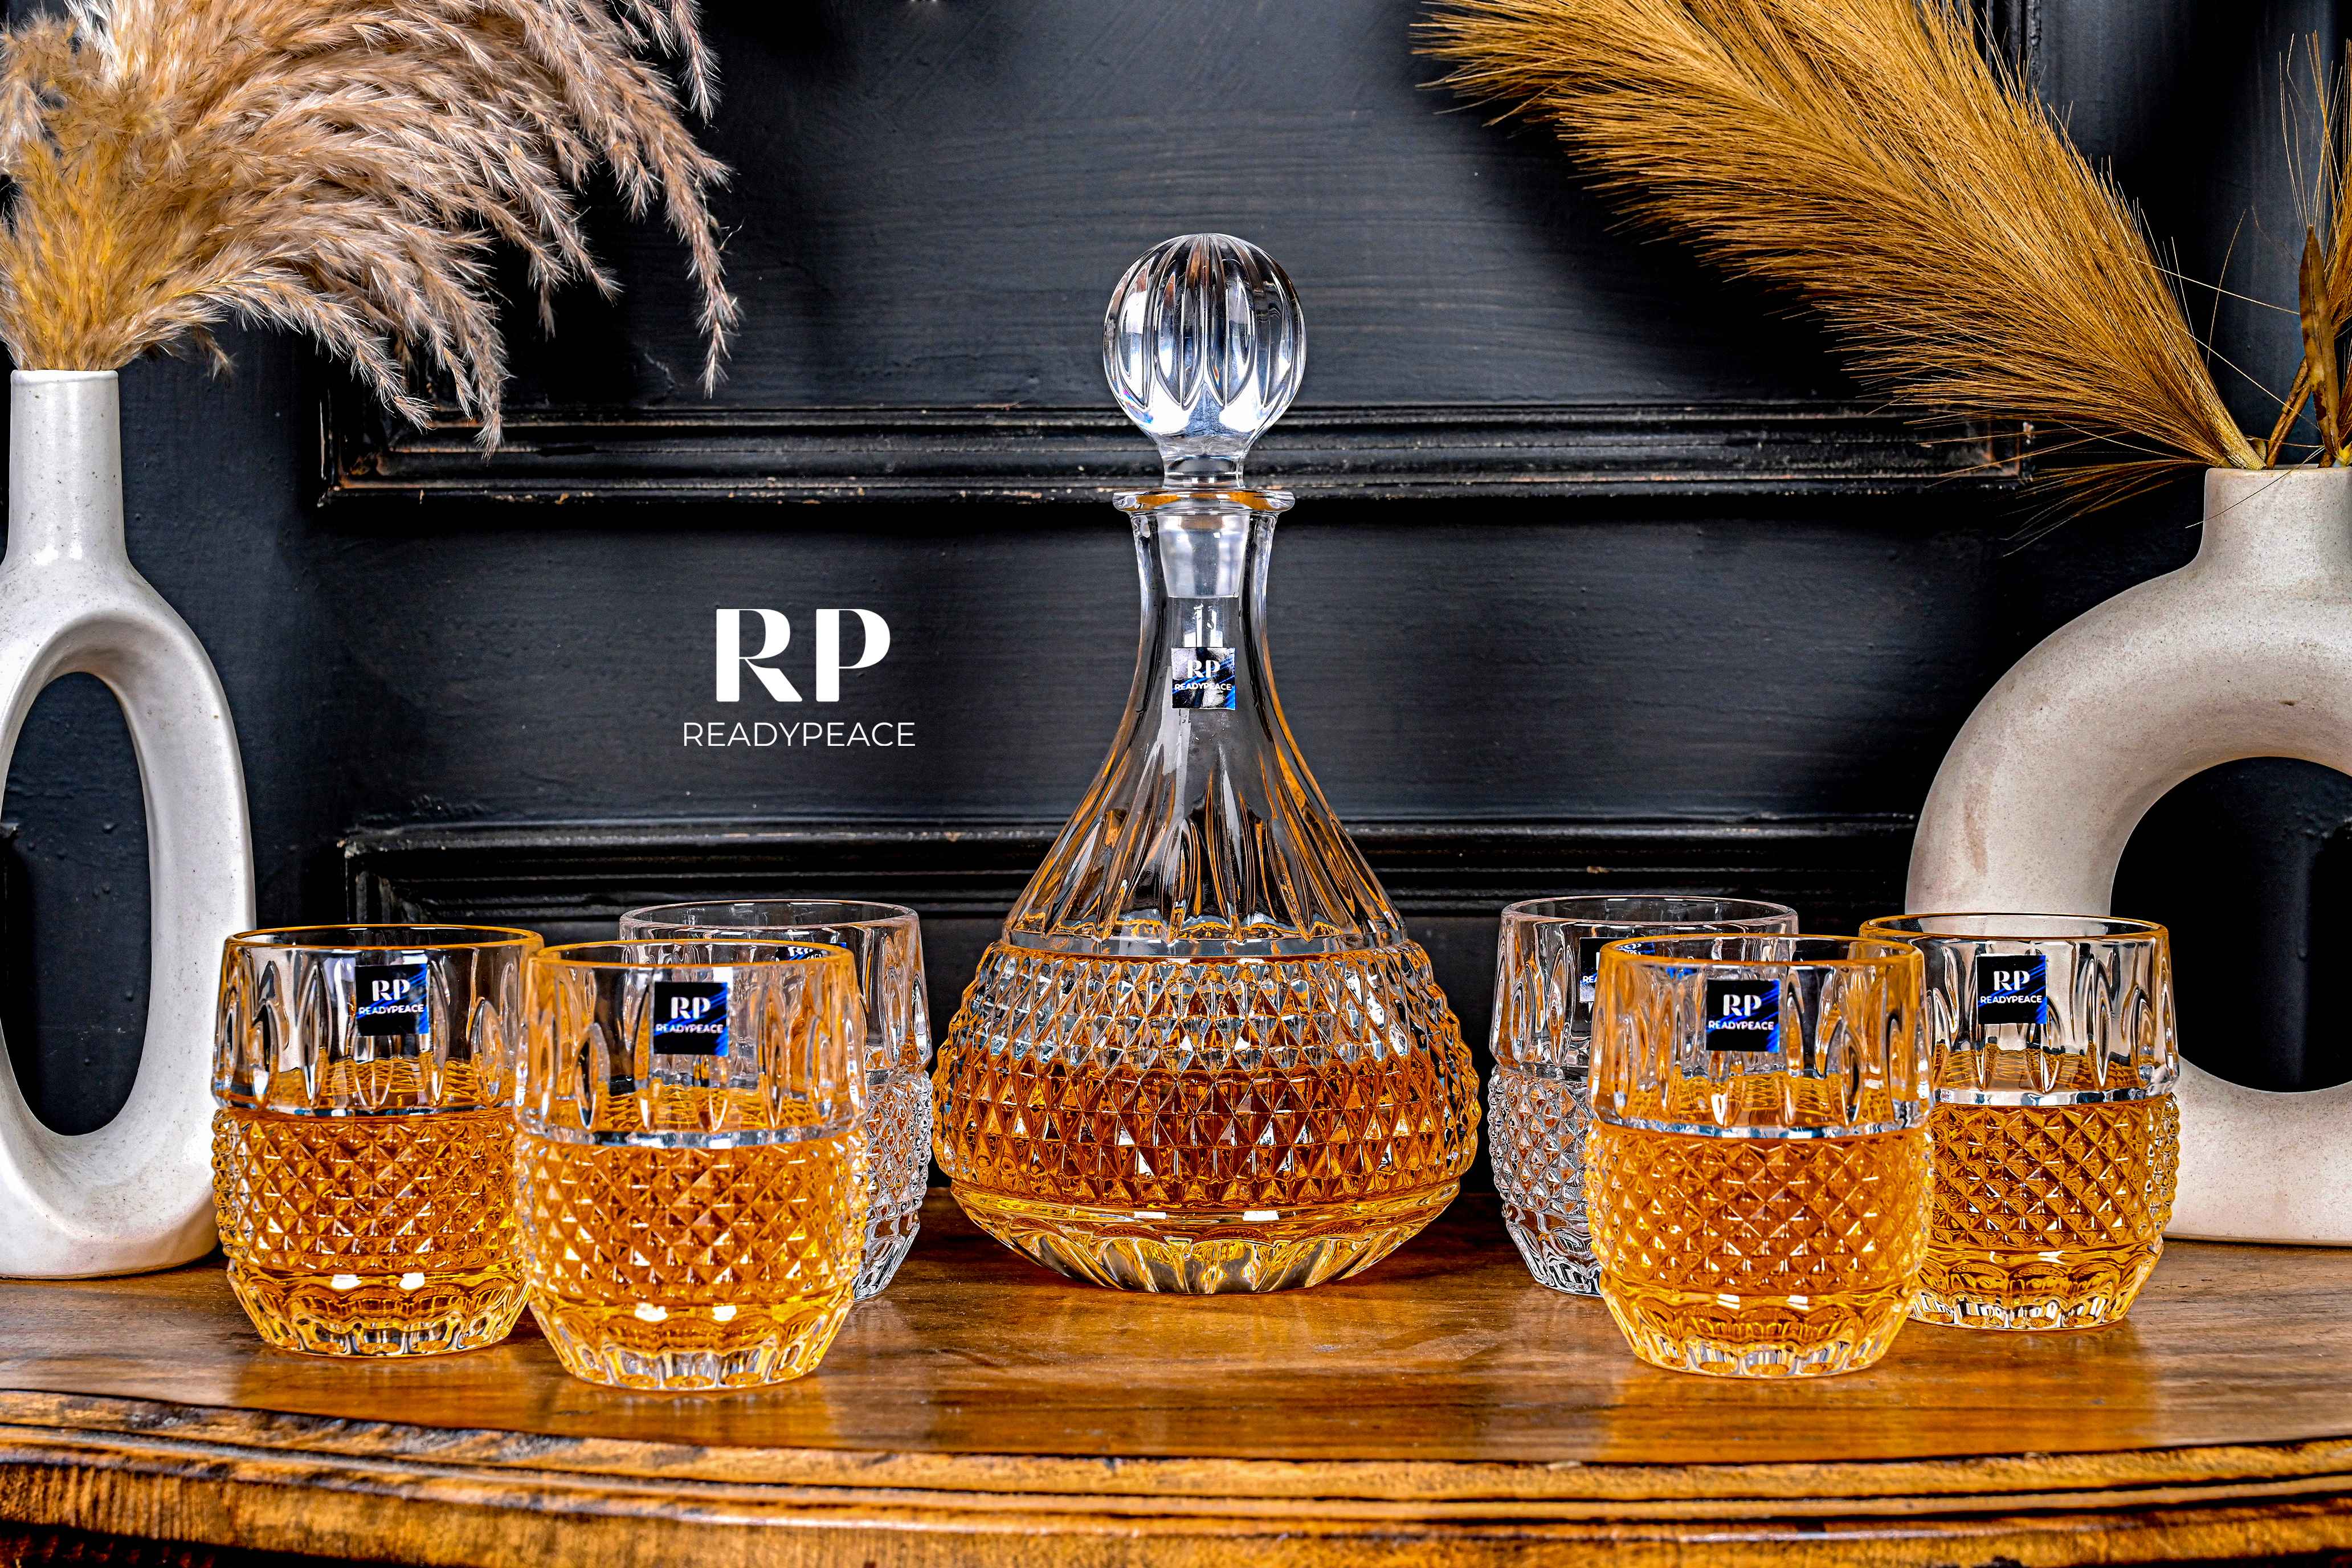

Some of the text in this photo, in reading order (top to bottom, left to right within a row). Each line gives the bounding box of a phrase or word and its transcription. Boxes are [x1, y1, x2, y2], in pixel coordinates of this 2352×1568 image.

[1187, 660, 1220, 678] RP
[1993, 970, 2030, 991] RP
[371, 979, 410, 1002] RP
[1980, 995, 2043, 1004] READYPEACE
[358, 1004, 424, 1015] READYPEACE
[671, 997, 711, 1019] RP
[1723, 994, 1762, 1016] RP
[655, 1024, 724, 1034] READYPEACE
[1708, 1020, 1774, 1030] READYPEACE
